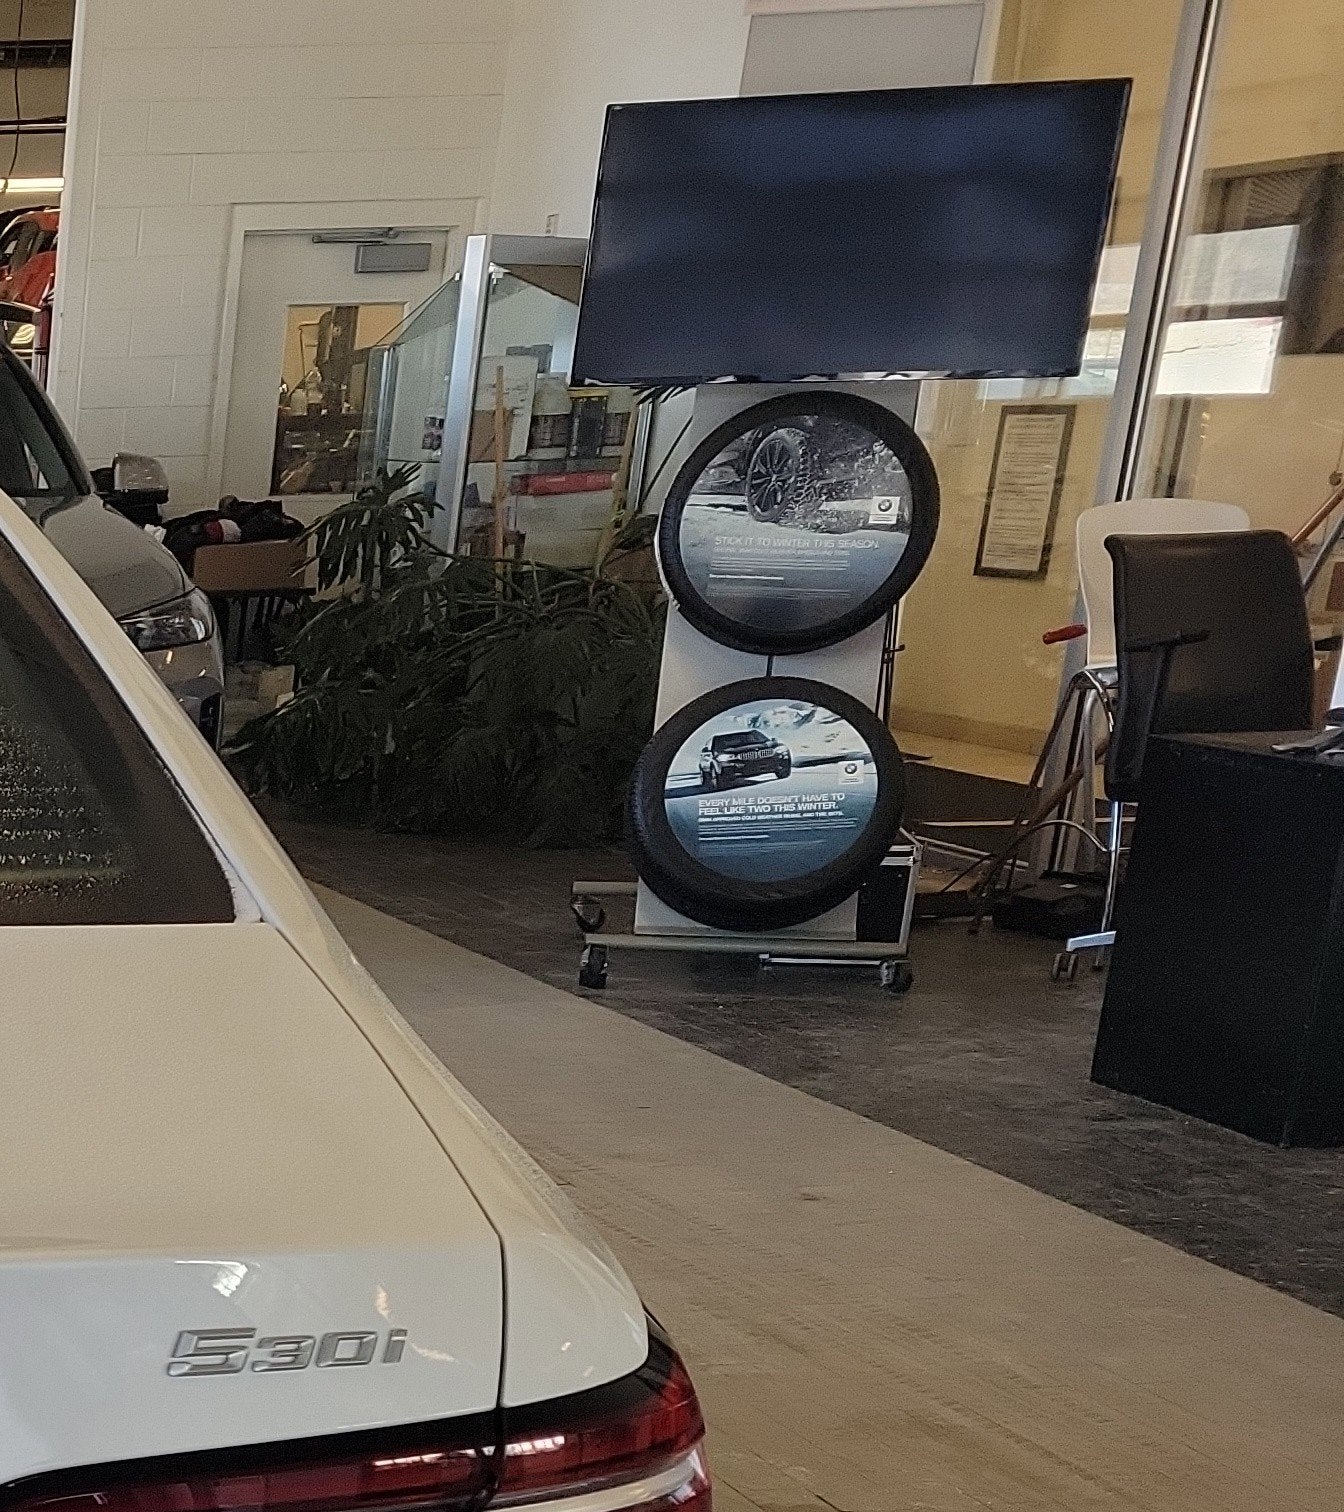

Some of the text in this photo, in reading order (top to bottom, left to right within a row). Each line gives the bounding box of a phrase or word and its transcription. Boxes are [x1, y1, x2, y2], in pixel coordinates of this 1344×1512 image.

[757, 537, 771, 547] TO
[773, 538, 810, 549] WINTER
[698, 792, 846, 807] EVERY MILE DOESN'T HAVE TO
[698, 801, 839, 816] FEEL LIKE TWO THIS WINTER.
[167, 1326, 408, 1378] 530i
